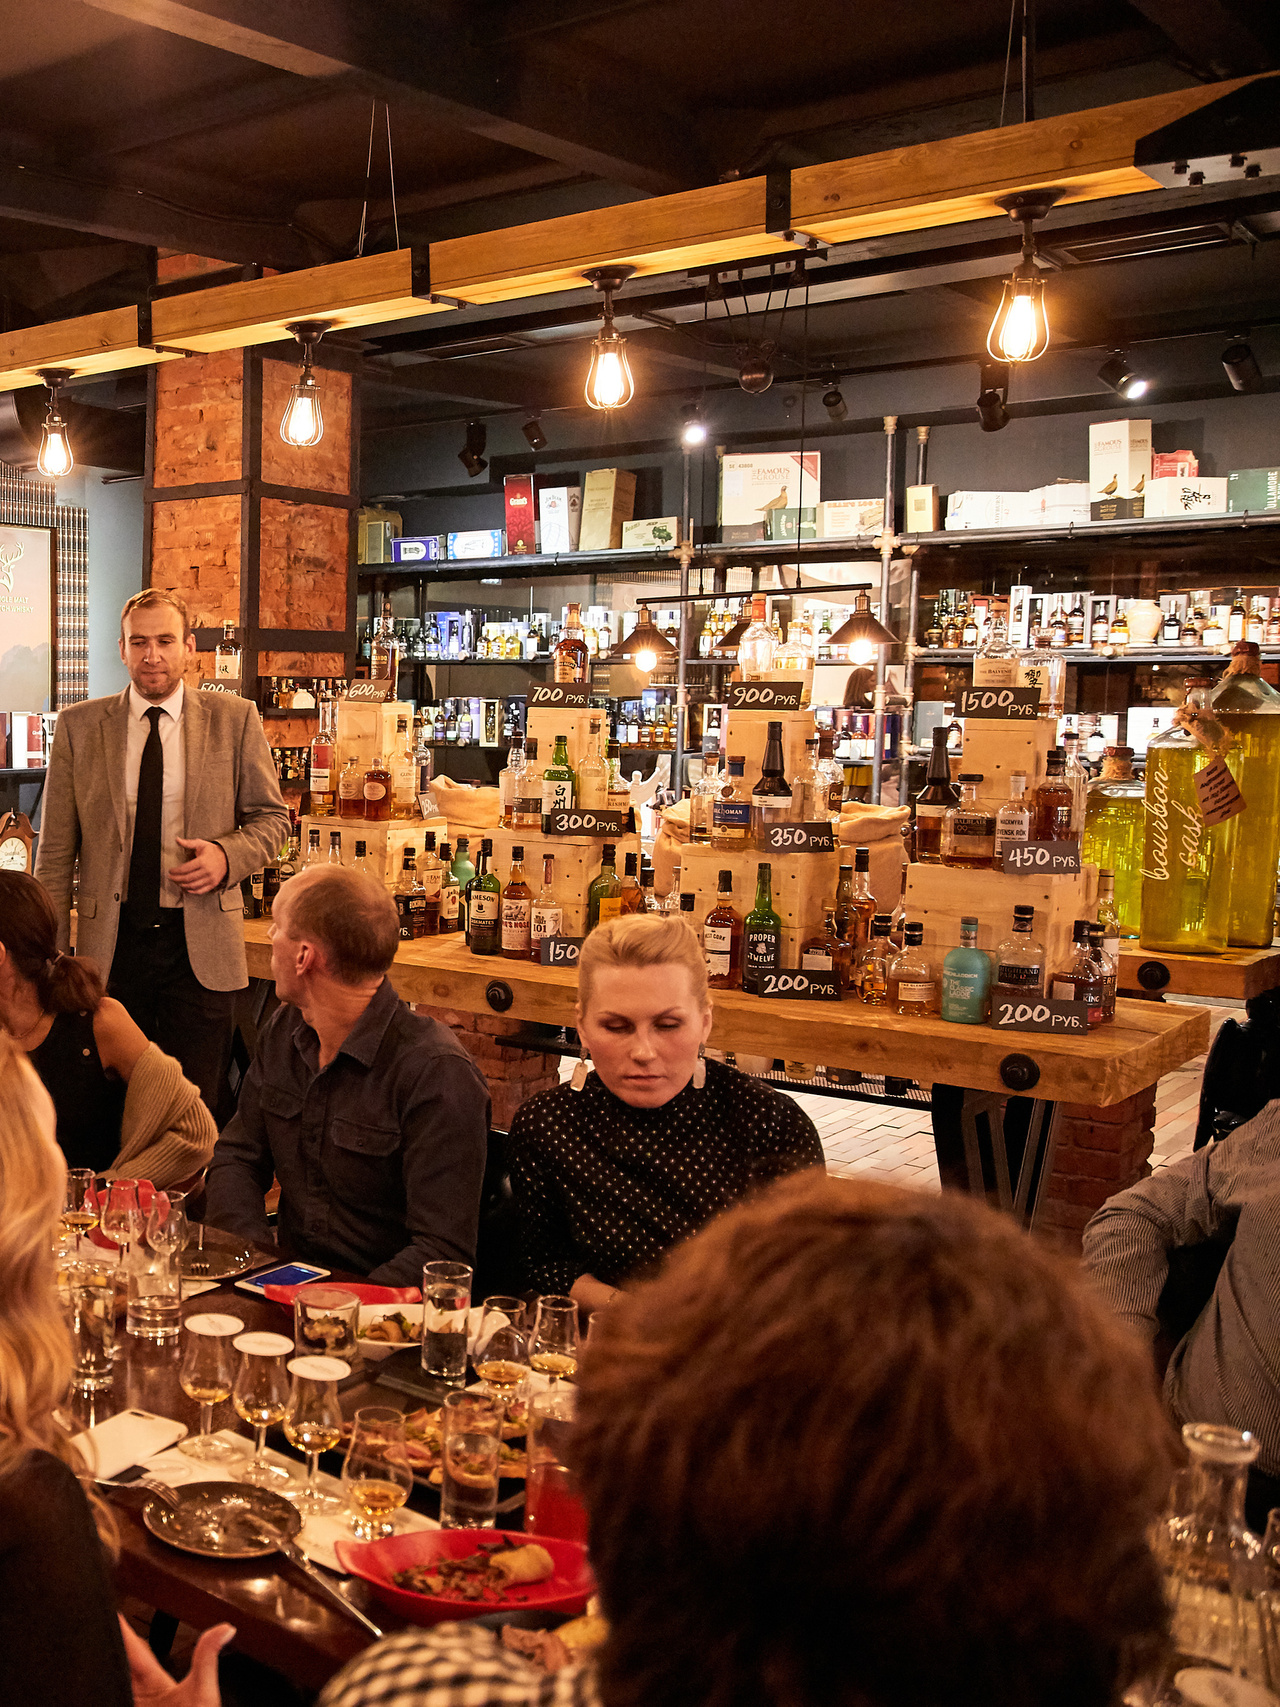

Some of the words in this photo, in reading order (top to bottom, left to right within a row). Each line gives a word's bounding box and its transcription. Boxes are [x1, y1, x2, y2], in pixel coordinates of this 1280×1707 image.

[757, 467, 790, 475] FAMOUS
[757, 473, 790, 481] GROUSE
[827, 500, 856, 508] BEAM'S
[858, 499, 874, 507] LOG
[875, 499, 885, 507] CA
[13, 596, 29, 605] MALT
[12, 605, 34, 614] WHISKY
[348, 683, 375, 698] 600
[532, 686, 564, 703] 700
[565, 694, 586, 704] РУБ.
[733, 687, 774, 706] 900
[774, 694, 798, 705] РУБ.
[961, 689, 1015, 713] 1500
[1008, 703, 1036, 716] РУБ.
[555, 813, 597, 832] 300
[596, 821, 621, 832] РУБ.
[1139, 764, 1170, 881] bourbon
[770, 827, 807, 848] 350
[809, 836, 833, 847] РУБ.
[1015, 828, 1026, 837] RÖK
[1170, 799, 1204, 867] cask
[1008, 846, 1050, 868] 450
[1052, 856, 1079, 868] РУБ.
[533, 923, 547, 933] 101
[713, 933, 726, 941] CORK
[749, 933, 776, 944] PROPER
[549, 941, 580, 962] 150
[749, 952, 775, 963] TWELVE
[999, 966, 1039, 975] HIGHLAND
[763, 974, 809, 994] 200
[809, 984, 838, 995] РУБ.
[949, 985, 975, 993] CLASSIC
[949, 991, 971, 999] LADDIE
[1083, 994, 1100, 1003] KING
[998, 1003, 1051, 1025] 200
[1051, 1014, 1084, 1028] РУБ.
